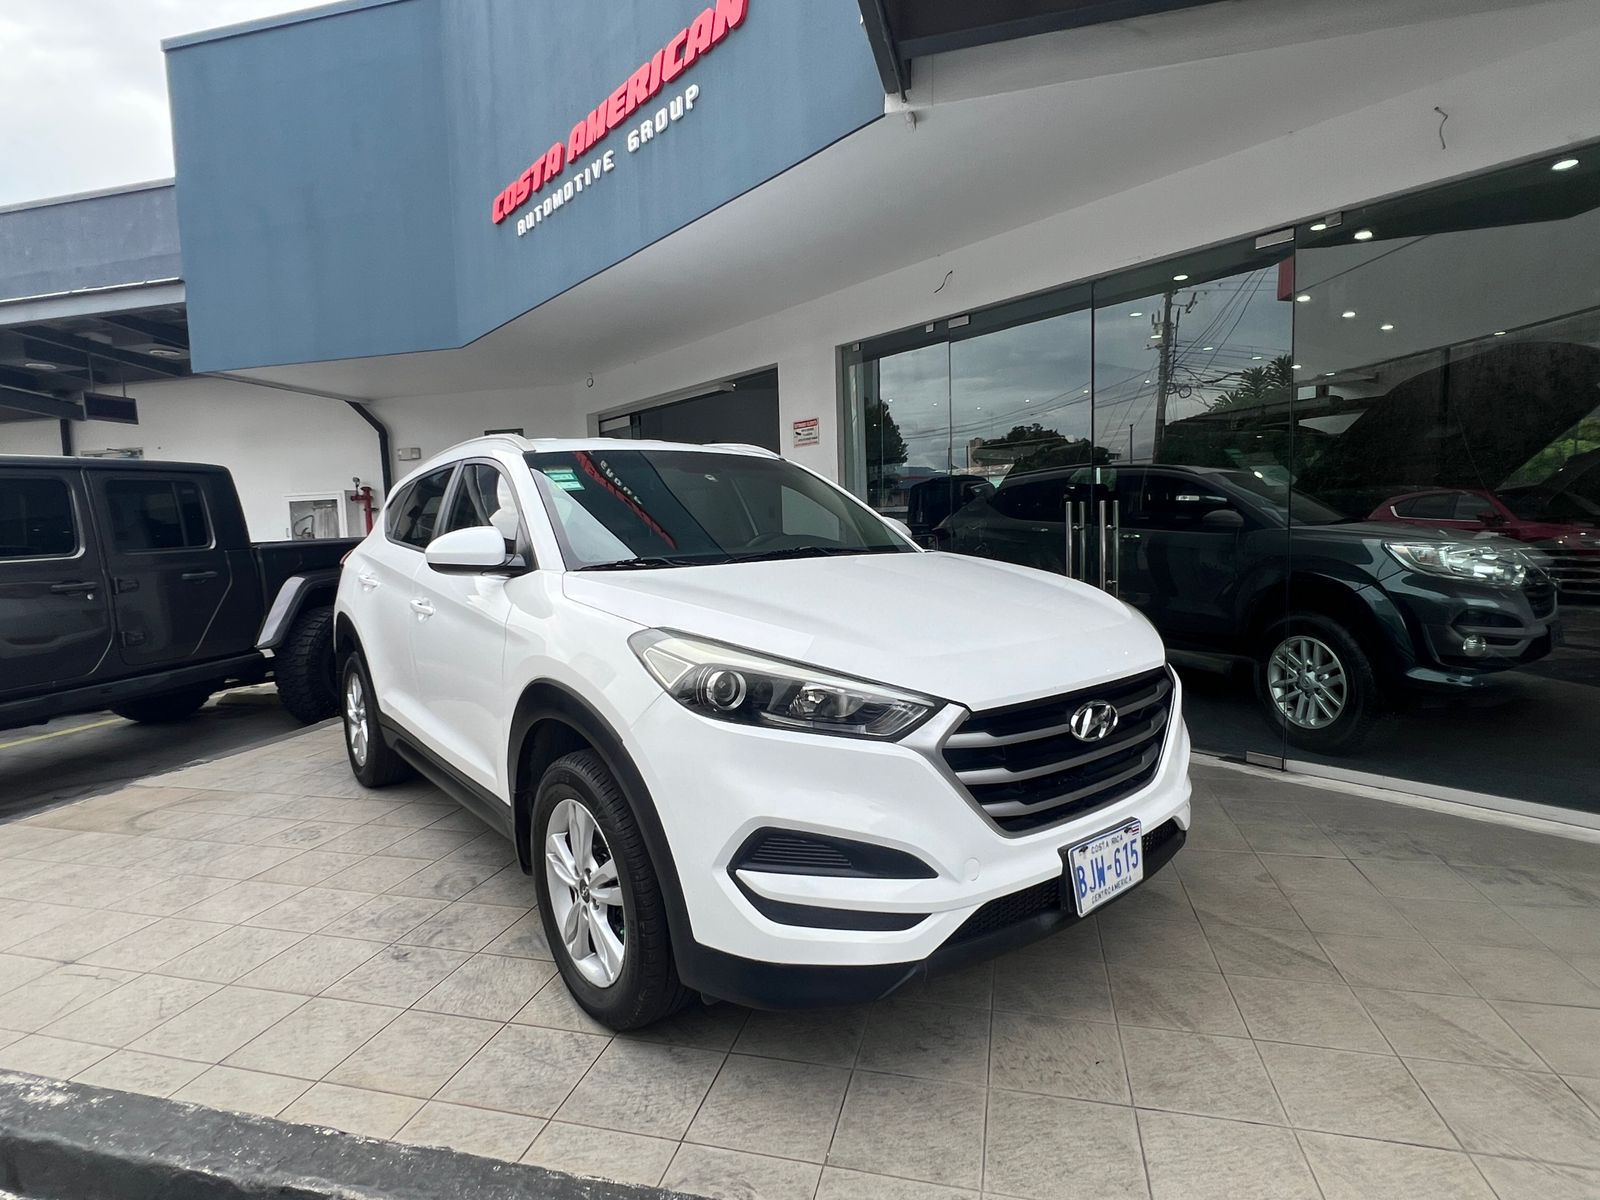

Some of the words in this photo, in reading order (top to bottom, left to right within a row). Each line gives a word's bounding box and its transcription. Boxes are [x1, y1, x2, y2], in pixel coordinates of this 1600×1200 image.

[492, 142, 566, 225] COSTA
[567, 0, 749, 165] AMERICAN
[517, 149, 615, 237] AUTOMOTIVE
[627, 83, 700, 153] GROUP
[1076, 838, 1139, 899] BJW-615
[1091, 840, 1110, 855] COSTA
